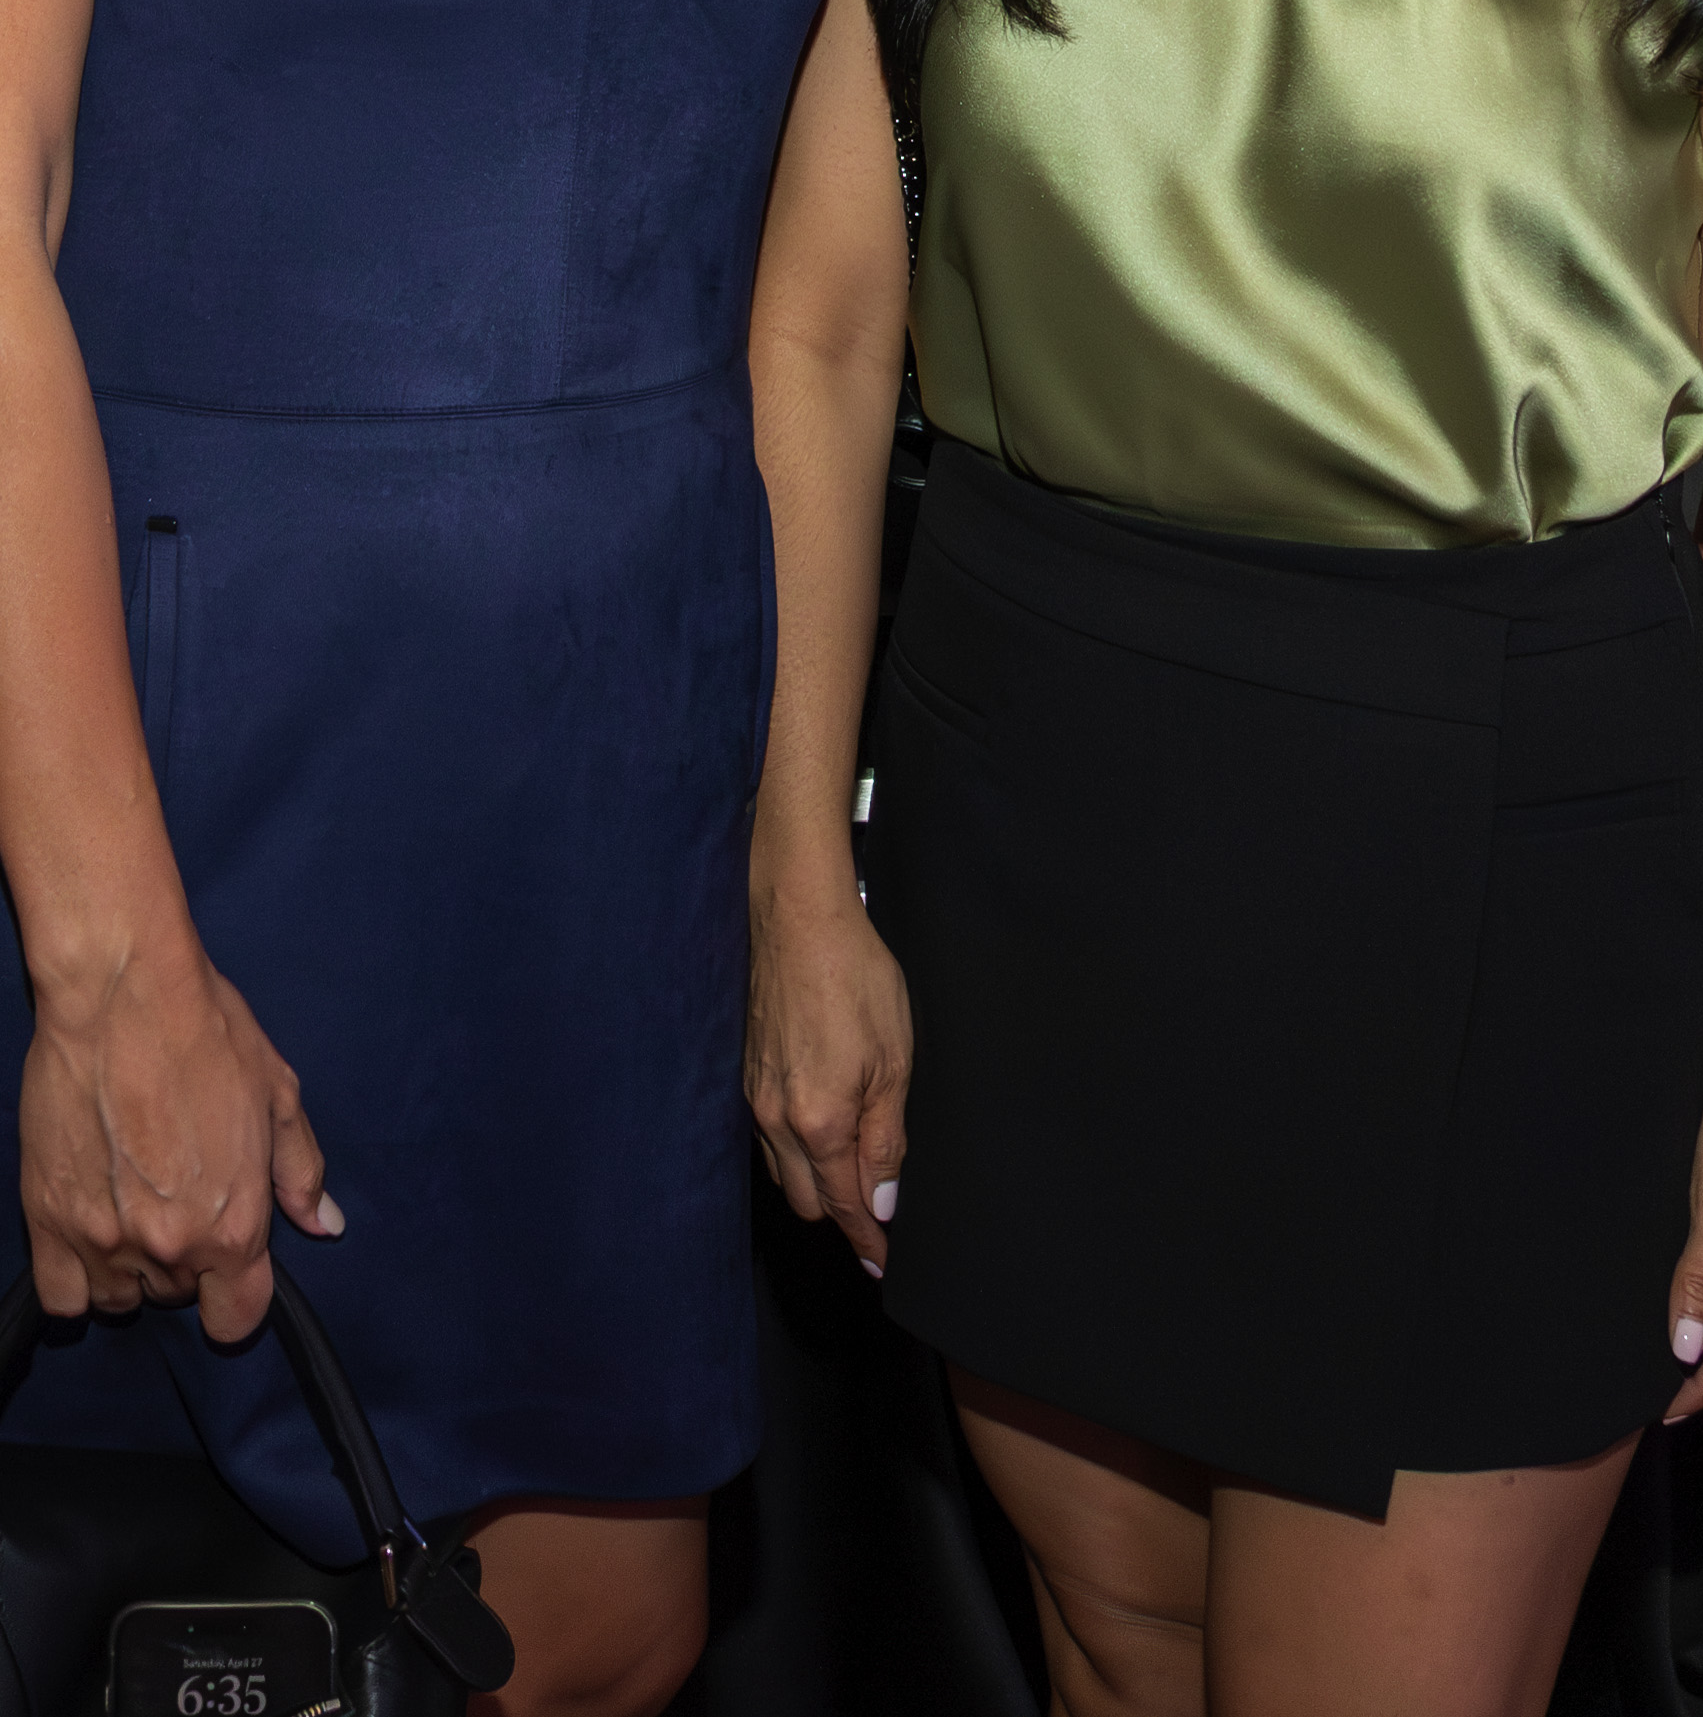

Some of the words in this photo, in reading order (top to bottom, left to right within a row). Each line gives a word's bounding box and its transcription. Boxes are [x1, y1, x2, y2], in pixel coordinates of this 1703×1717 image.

[228, 1657, 249, 1669] April
[250, 1656, 263, 1669] 27
[177, 1674, 267, 1716] 6:35
